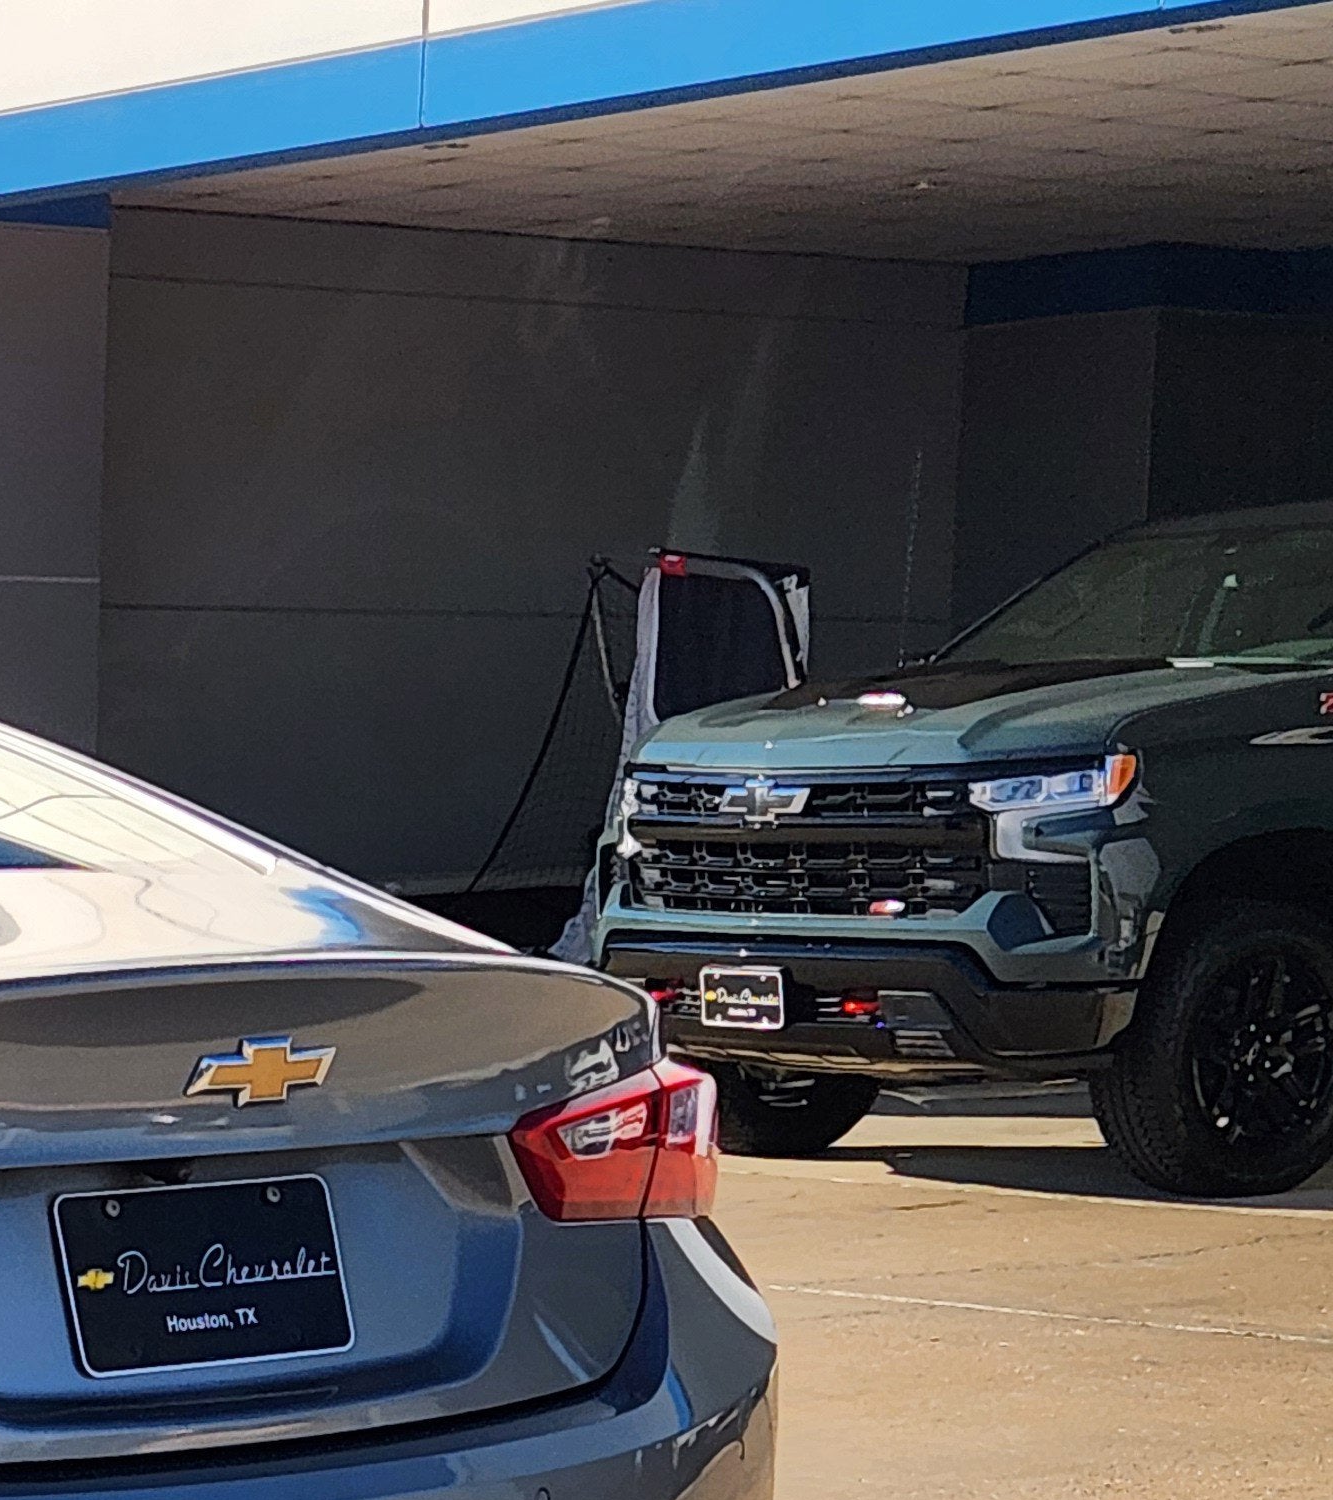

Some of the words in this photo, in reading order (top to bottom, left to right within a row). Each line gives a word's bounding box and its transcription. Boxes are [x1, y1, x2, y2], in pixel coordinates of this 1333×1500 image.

[117, 1251, 199, 1295] Davis
[199, 1243, 336, 1288] Chevrolet
[165, 1313, 234, 1333] Houston,
[235, 1307, 259, 1326] TX
